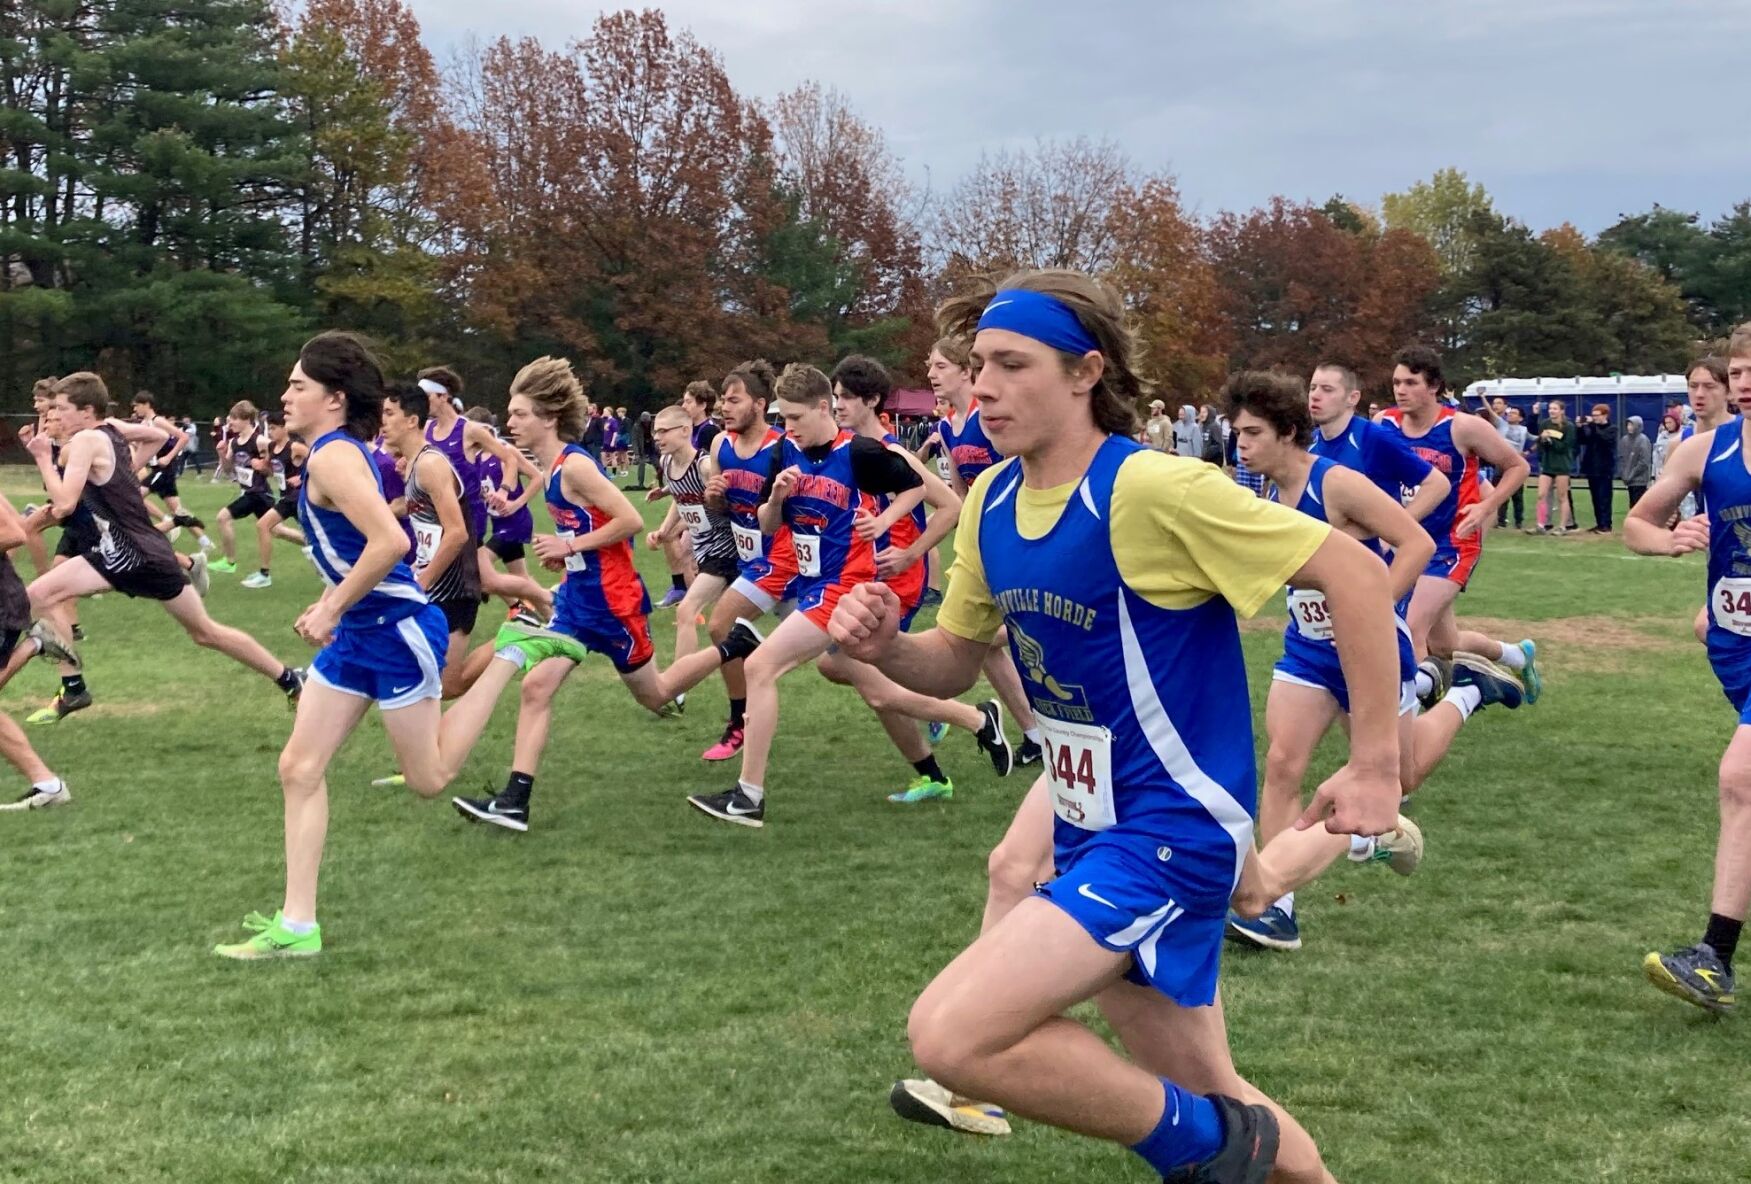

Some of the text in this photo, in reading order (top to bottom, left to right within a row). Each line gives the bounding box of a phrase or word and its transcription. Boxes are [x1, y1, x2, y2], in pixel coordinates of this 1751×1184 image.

[735, 532, 754, 551] 60
[1043, 591, 1097, 632] HORDE
[1045, 736, 1096, 795] 344
